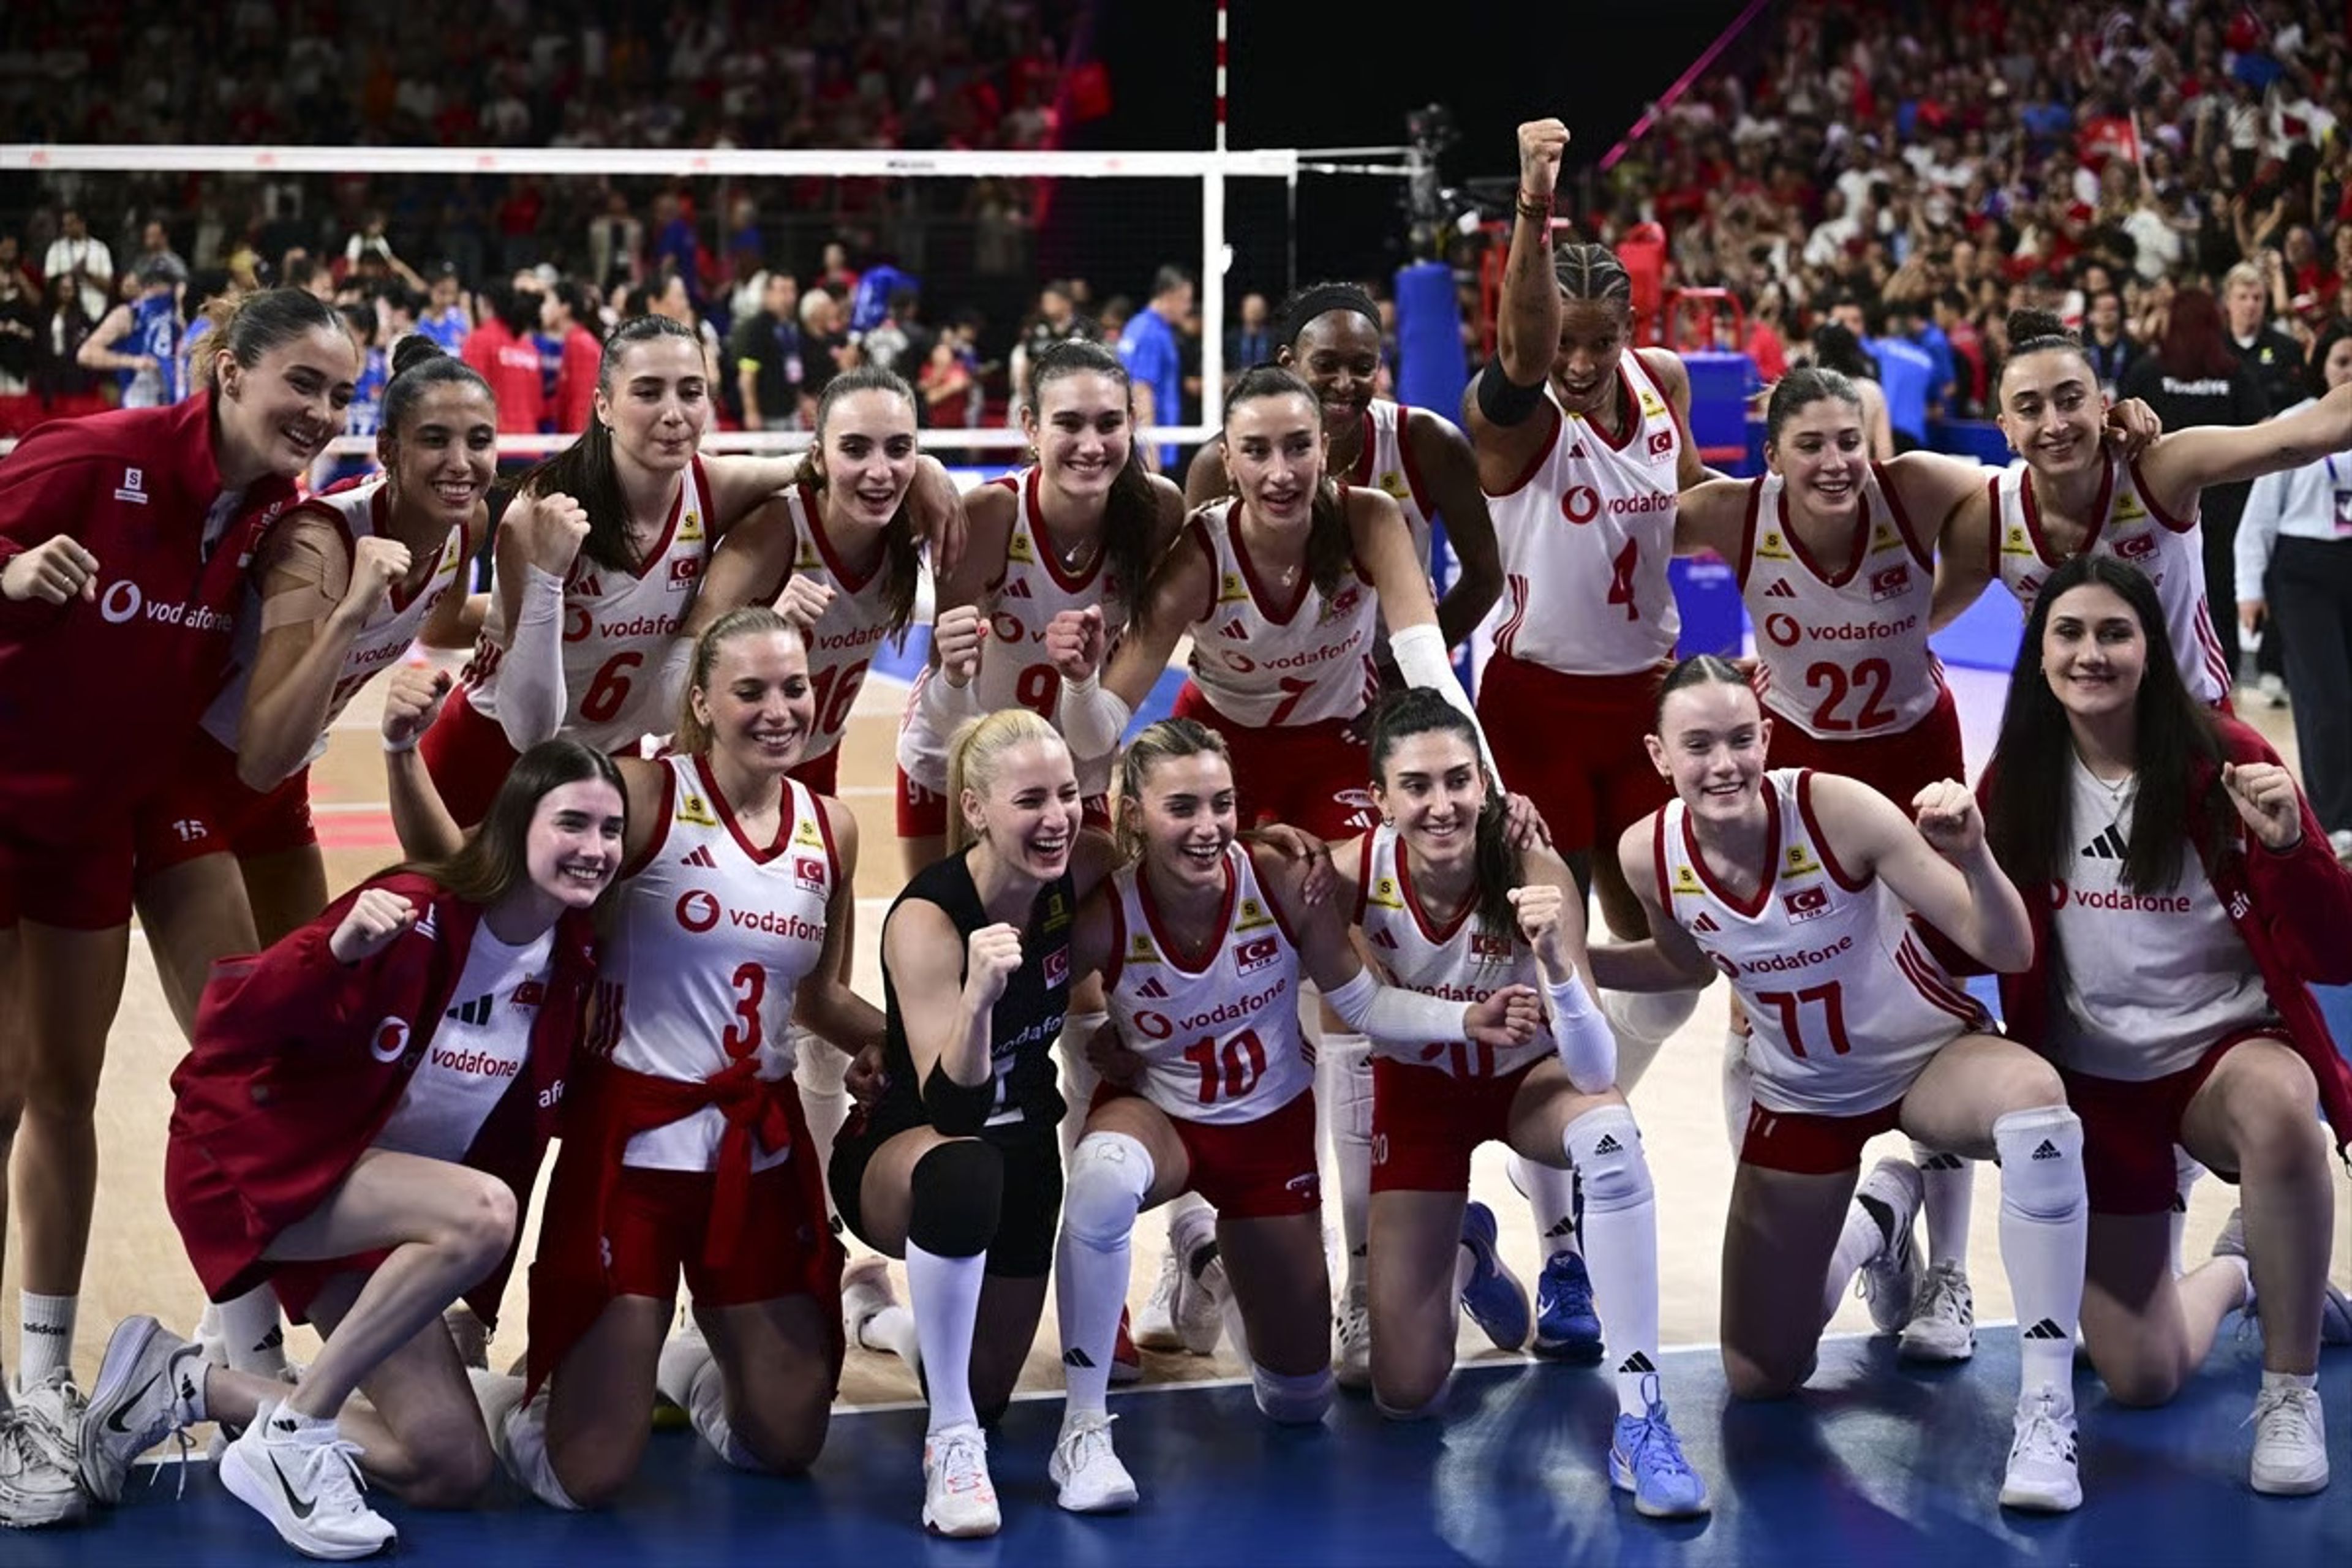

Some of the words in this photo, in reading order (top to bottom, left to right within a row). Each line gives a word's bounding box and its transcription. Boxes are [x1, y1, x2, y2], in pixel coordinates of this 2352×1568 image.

[129, 472, 138, 485] S
[1608, 537, 1639, 622] 4
[1807, 614, 1917, 641] vodafone
[1261, 630, 1361, 669] vodafone
[580, 651, 643, 722] 6
[1267, 676, 1317, 726] 7
[1806, 658, 1896, 731] 22
[173, 819, 208, 842] 15
[1799, 908, 1823, 919] TUR
[2075, 890, 2191, 911] vodafone
[1248, 957, 1271, 969] TUR
[1740, 935, 1853, 975] vodafone
[723, 962, 767, 1060] 3
[1179, 977, 1286, 1031] vodafone
[1755, 981, 1851, 1059] 77
[431, 1049, 519, 1077] vodafone
[1184, 1028, 1266, 1102] 10
